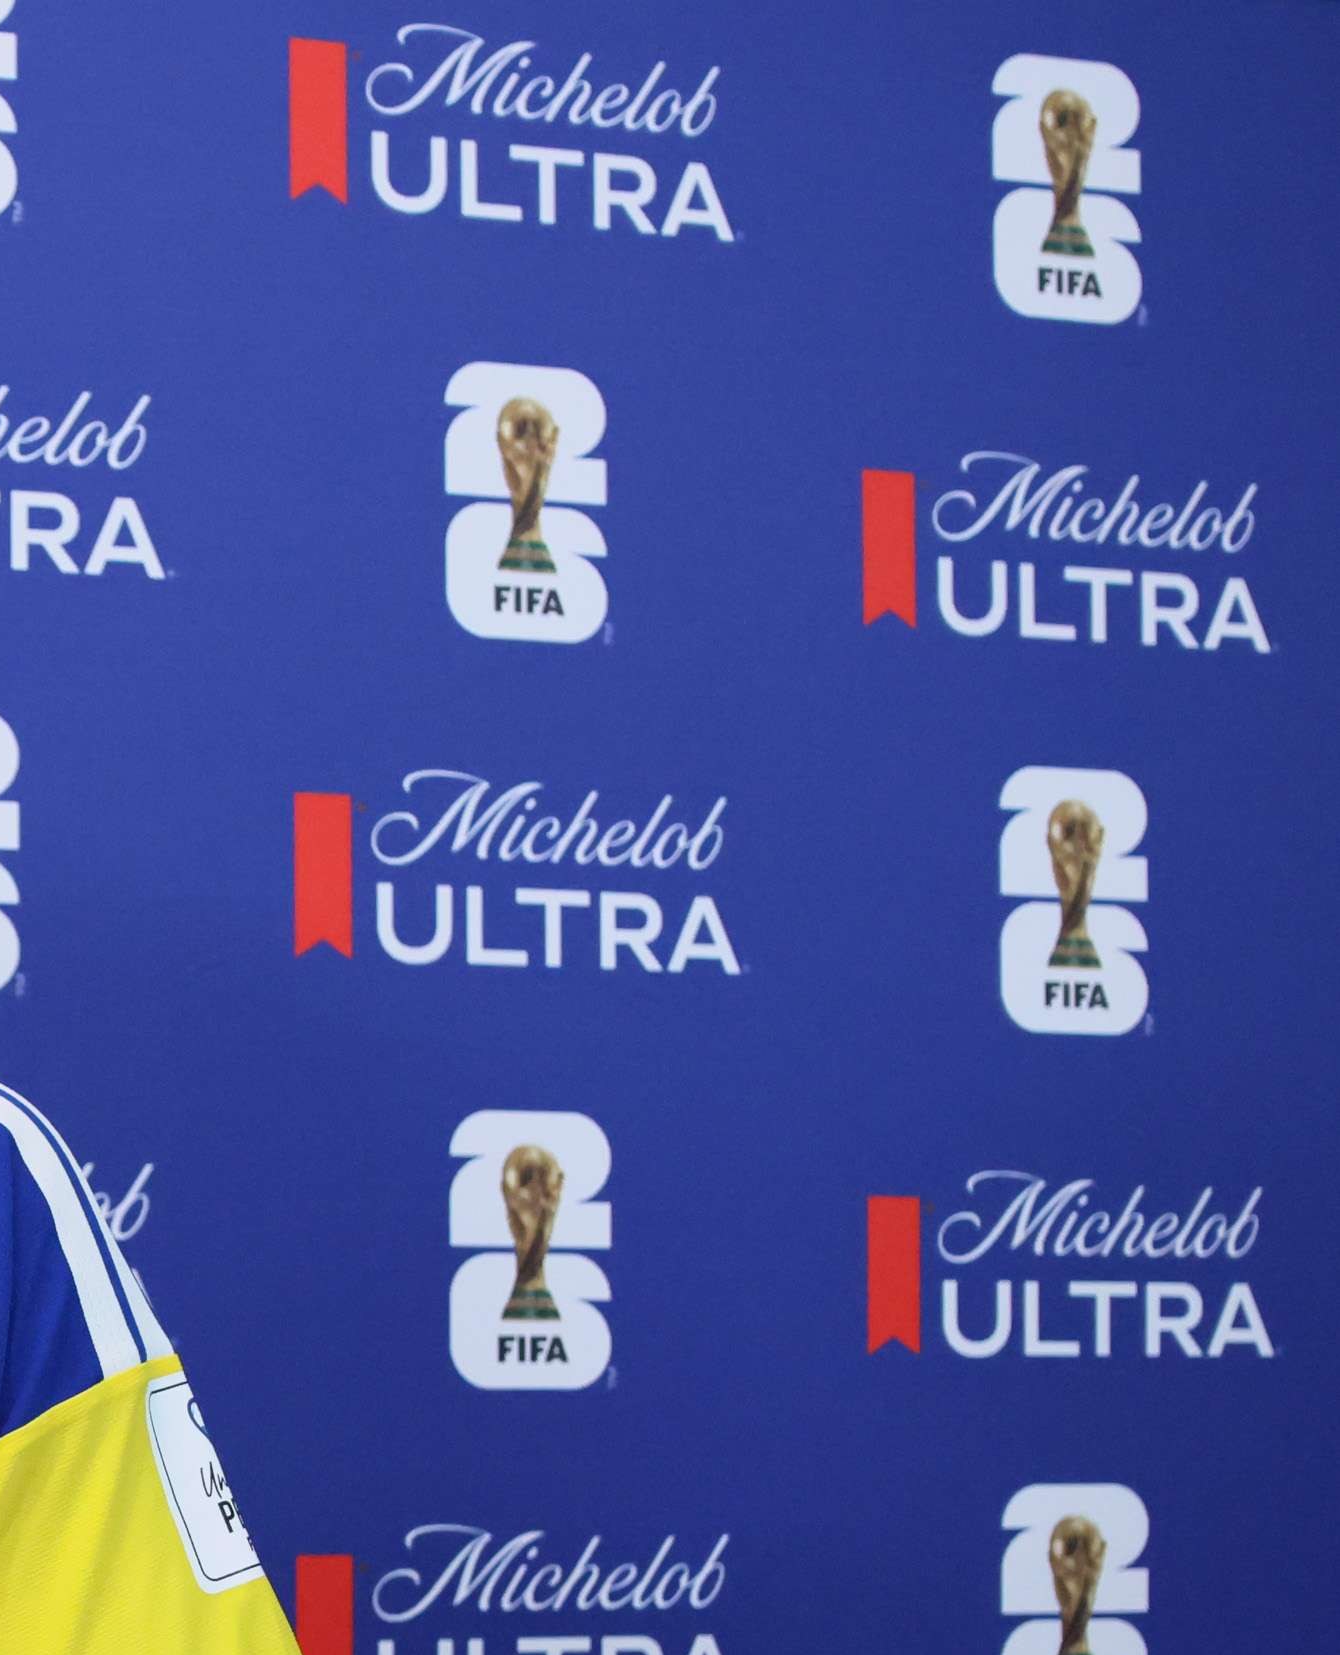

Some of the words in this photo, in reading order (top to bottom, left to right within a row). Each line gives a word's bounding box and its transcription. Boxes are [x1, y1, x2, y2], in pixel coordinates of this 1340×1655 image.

[366, 23, 719, 136] Michelob
[371, 131, 734, 242] ULTRA
[1038, 267, 1102, 298] FIFA
[932, 451, 1257, 553] Michelob
[494, 585, 564, 616] FIFA
[937, 556, 1270, 653] ULTRA
[371, 769, 726, 870] Michelob
[376, 882, 740, 975] ULTRA
[1044, 981, 1109, 1009] FIFA
[937, 1170, 1262, 1264] Michelob
[497, 1336, 568, 1363] FIFA
[942, 1279, 1274, 1358] ULTRA
[373, 1524, 729, 1622] Michelob
